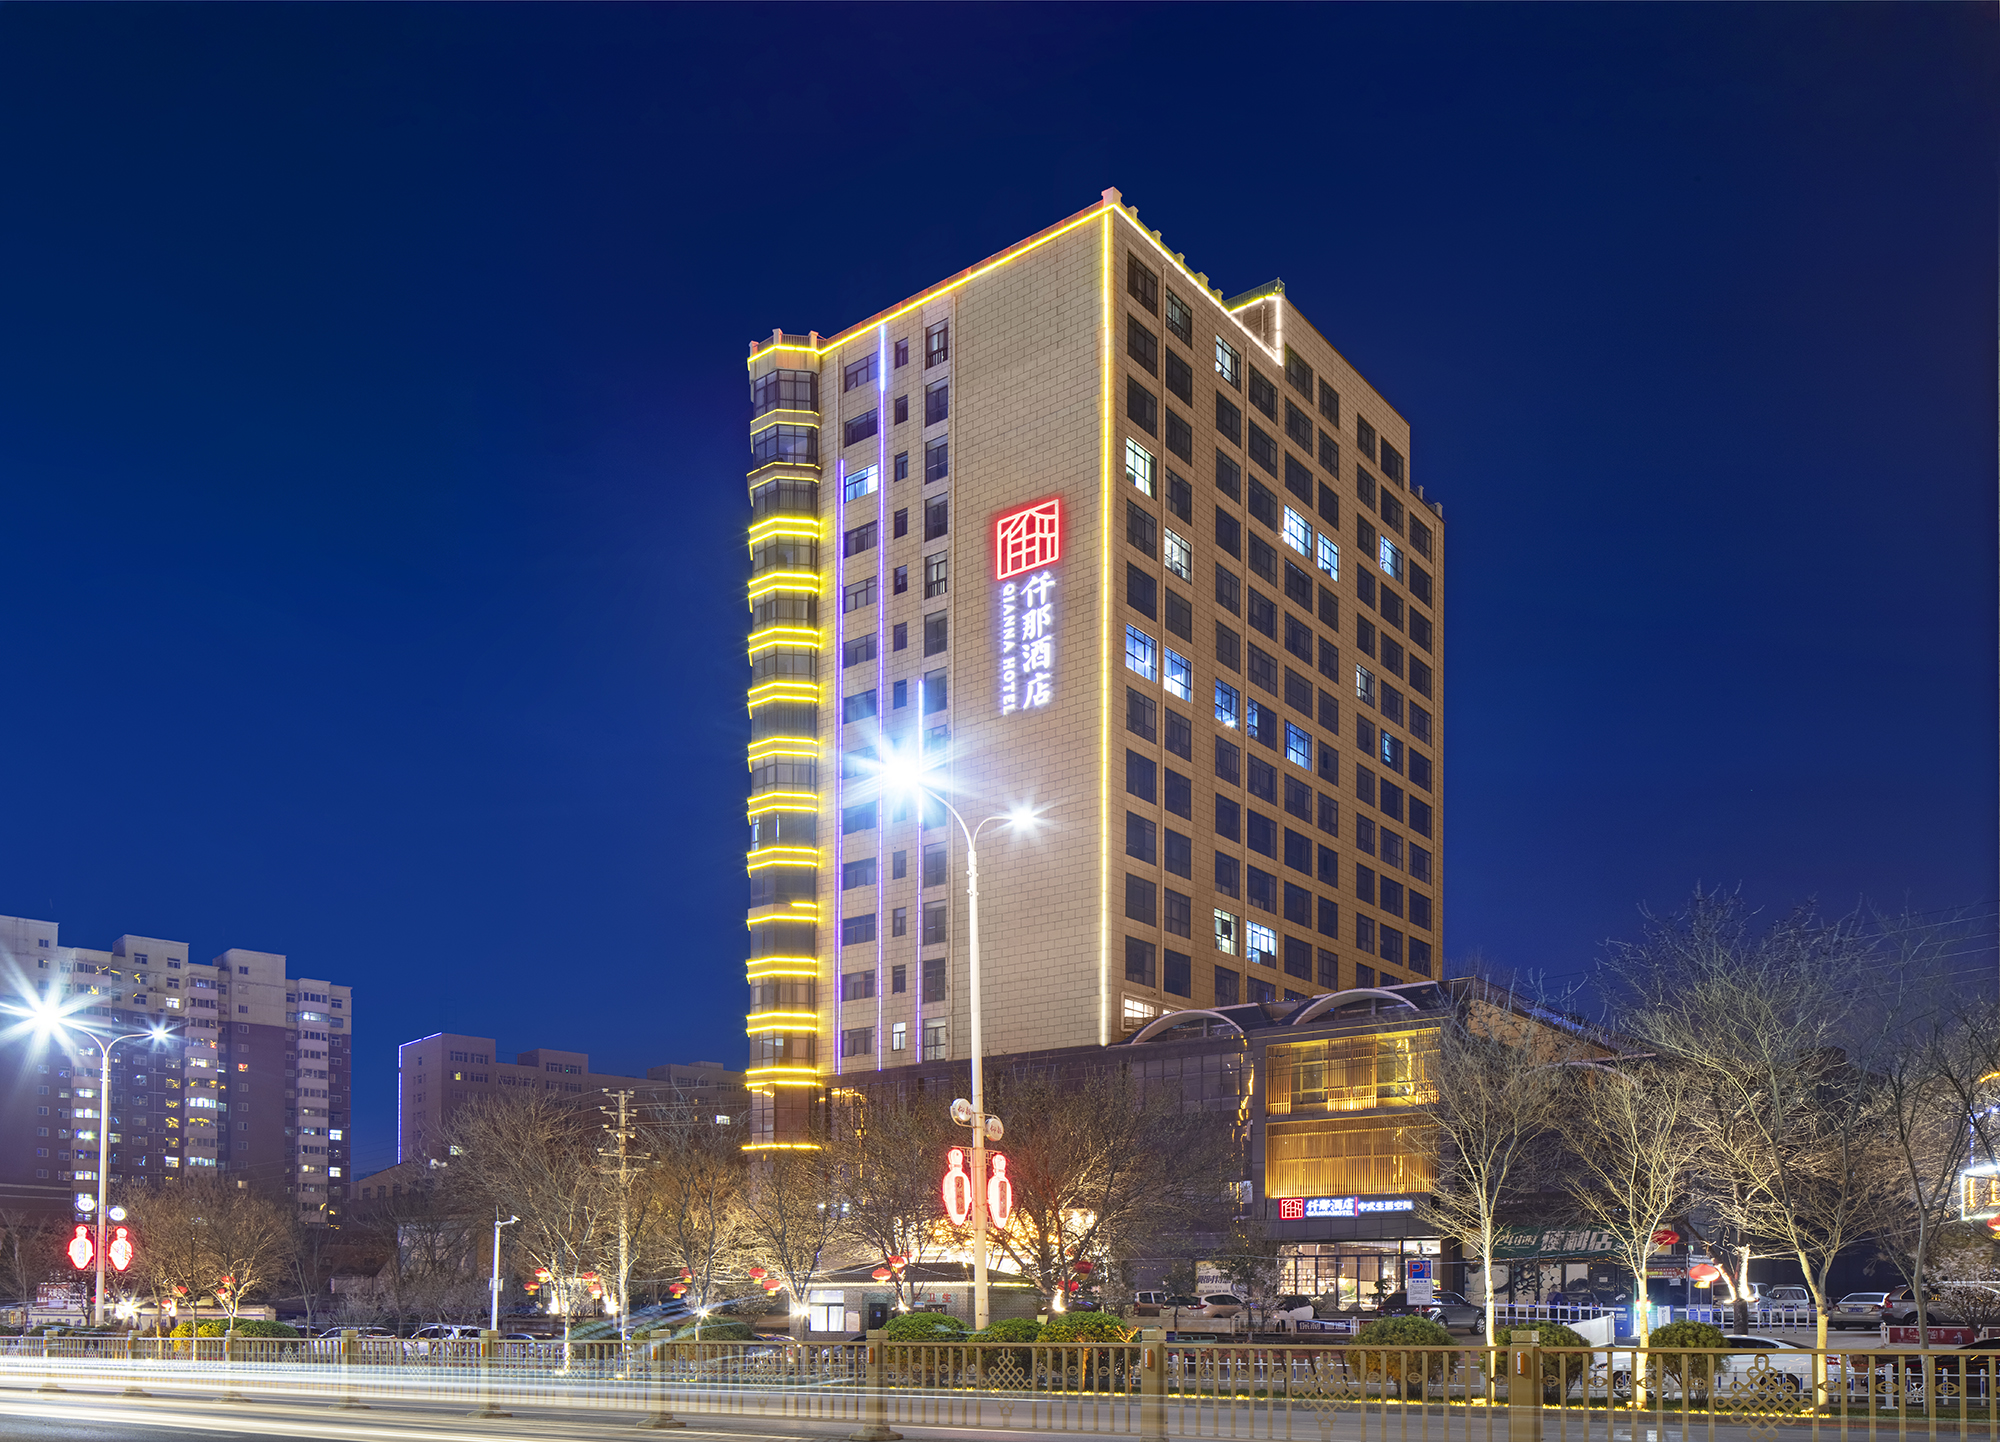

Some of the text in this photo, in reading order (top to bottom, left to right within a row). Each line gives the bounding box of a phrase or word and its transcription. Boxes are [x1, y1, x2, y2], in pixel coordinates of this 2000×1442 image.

[1020, 571, 1056, 709] 仟那酒店
[1002, 583, 1016, 715] QIANNA HOTEL
[1306, 1198, 1354, 1211] 仟那酒店
[1358, 1201, 1412, 1211] 中式生活空间
[1409, 1261, 1423, 1278] P
